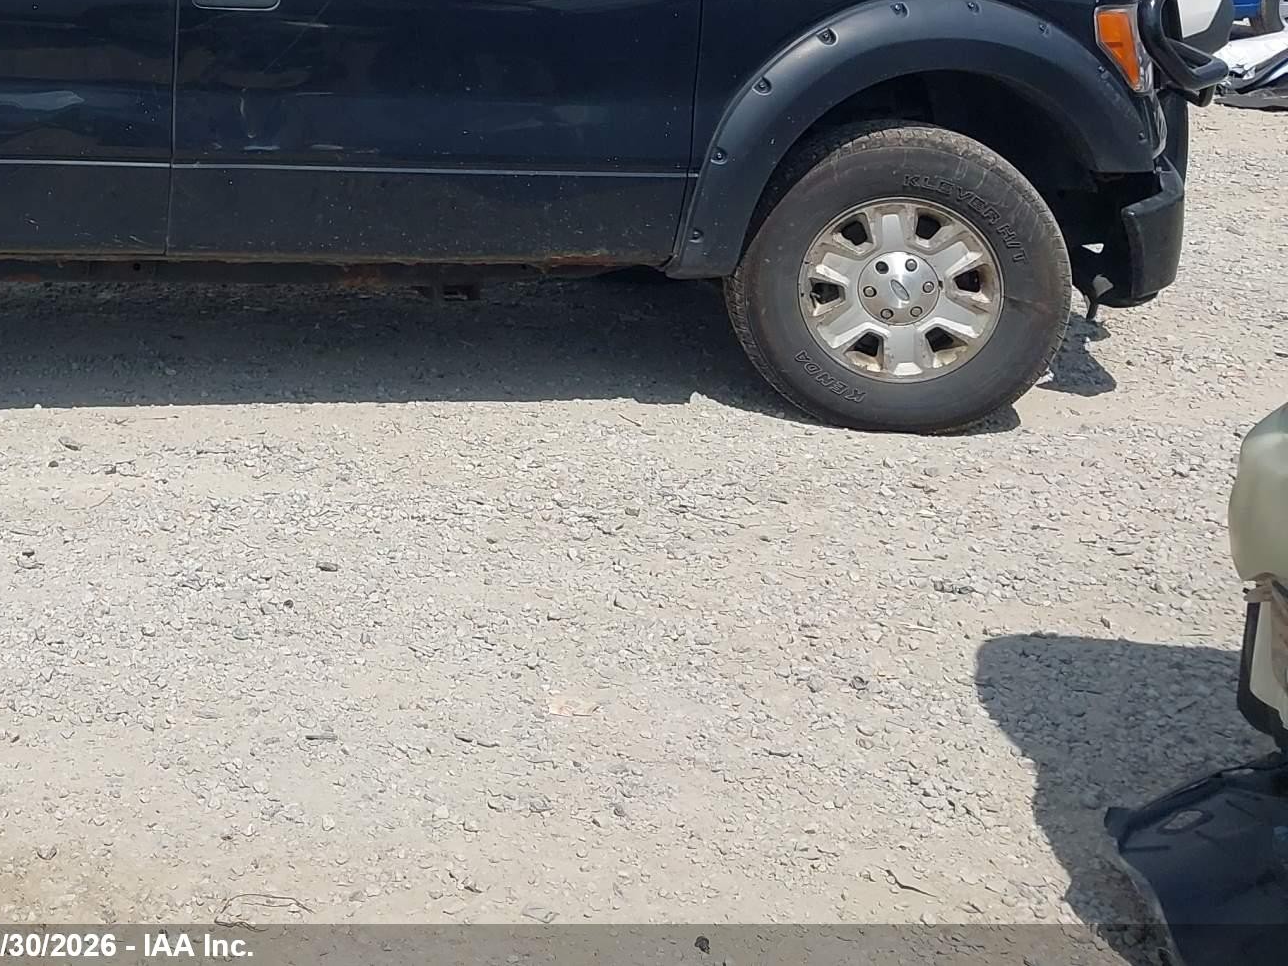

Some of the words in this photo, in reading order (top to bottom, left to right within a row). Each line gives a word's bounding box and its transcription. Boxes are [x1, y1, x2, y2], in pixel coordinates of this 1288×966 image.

[902, 173, 1001, 225] KLEVER
[997, 223, 1028, 264] H/T
[794, 348, 867, 404] KENDA
